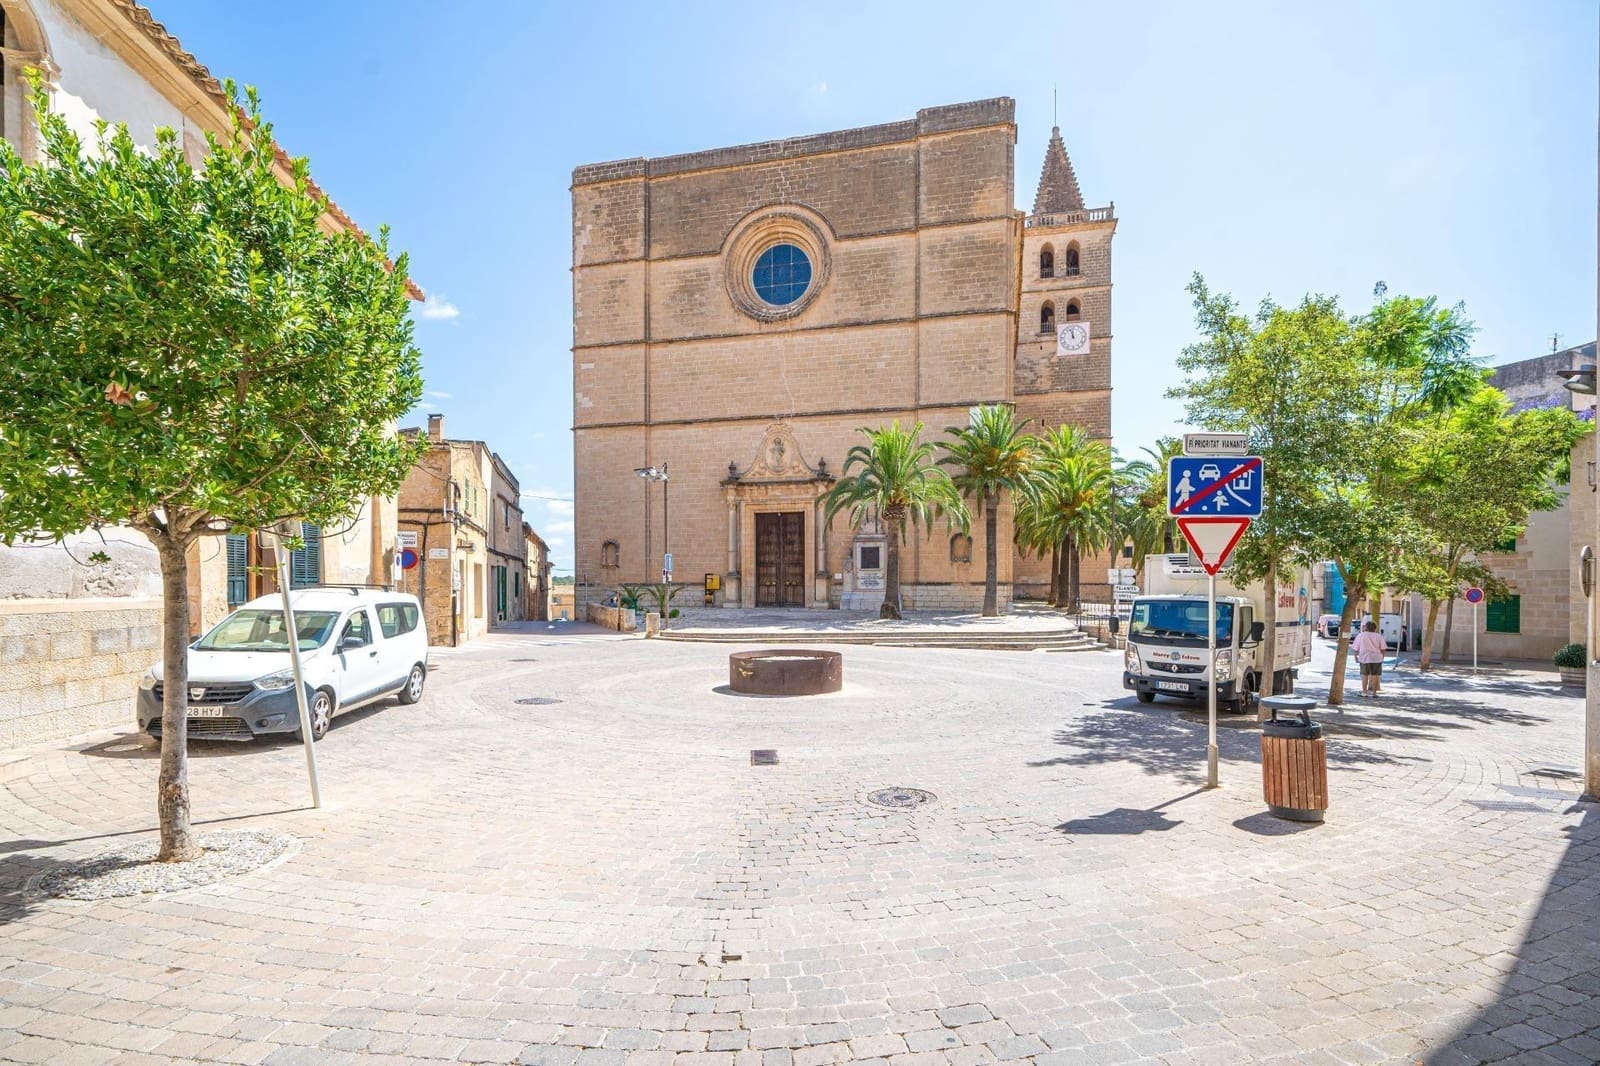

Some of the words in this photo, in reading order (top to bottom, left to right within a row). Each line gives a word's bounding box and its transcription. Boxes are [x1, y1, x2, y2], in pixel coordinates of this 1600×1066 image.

[1194, 440, 1219, 448] PRIORITAT
[1222, 440, 1246, 448] VIANANTS
[188, 708, 199, 716] 28
[202, 708, 220, 716] HYJ
